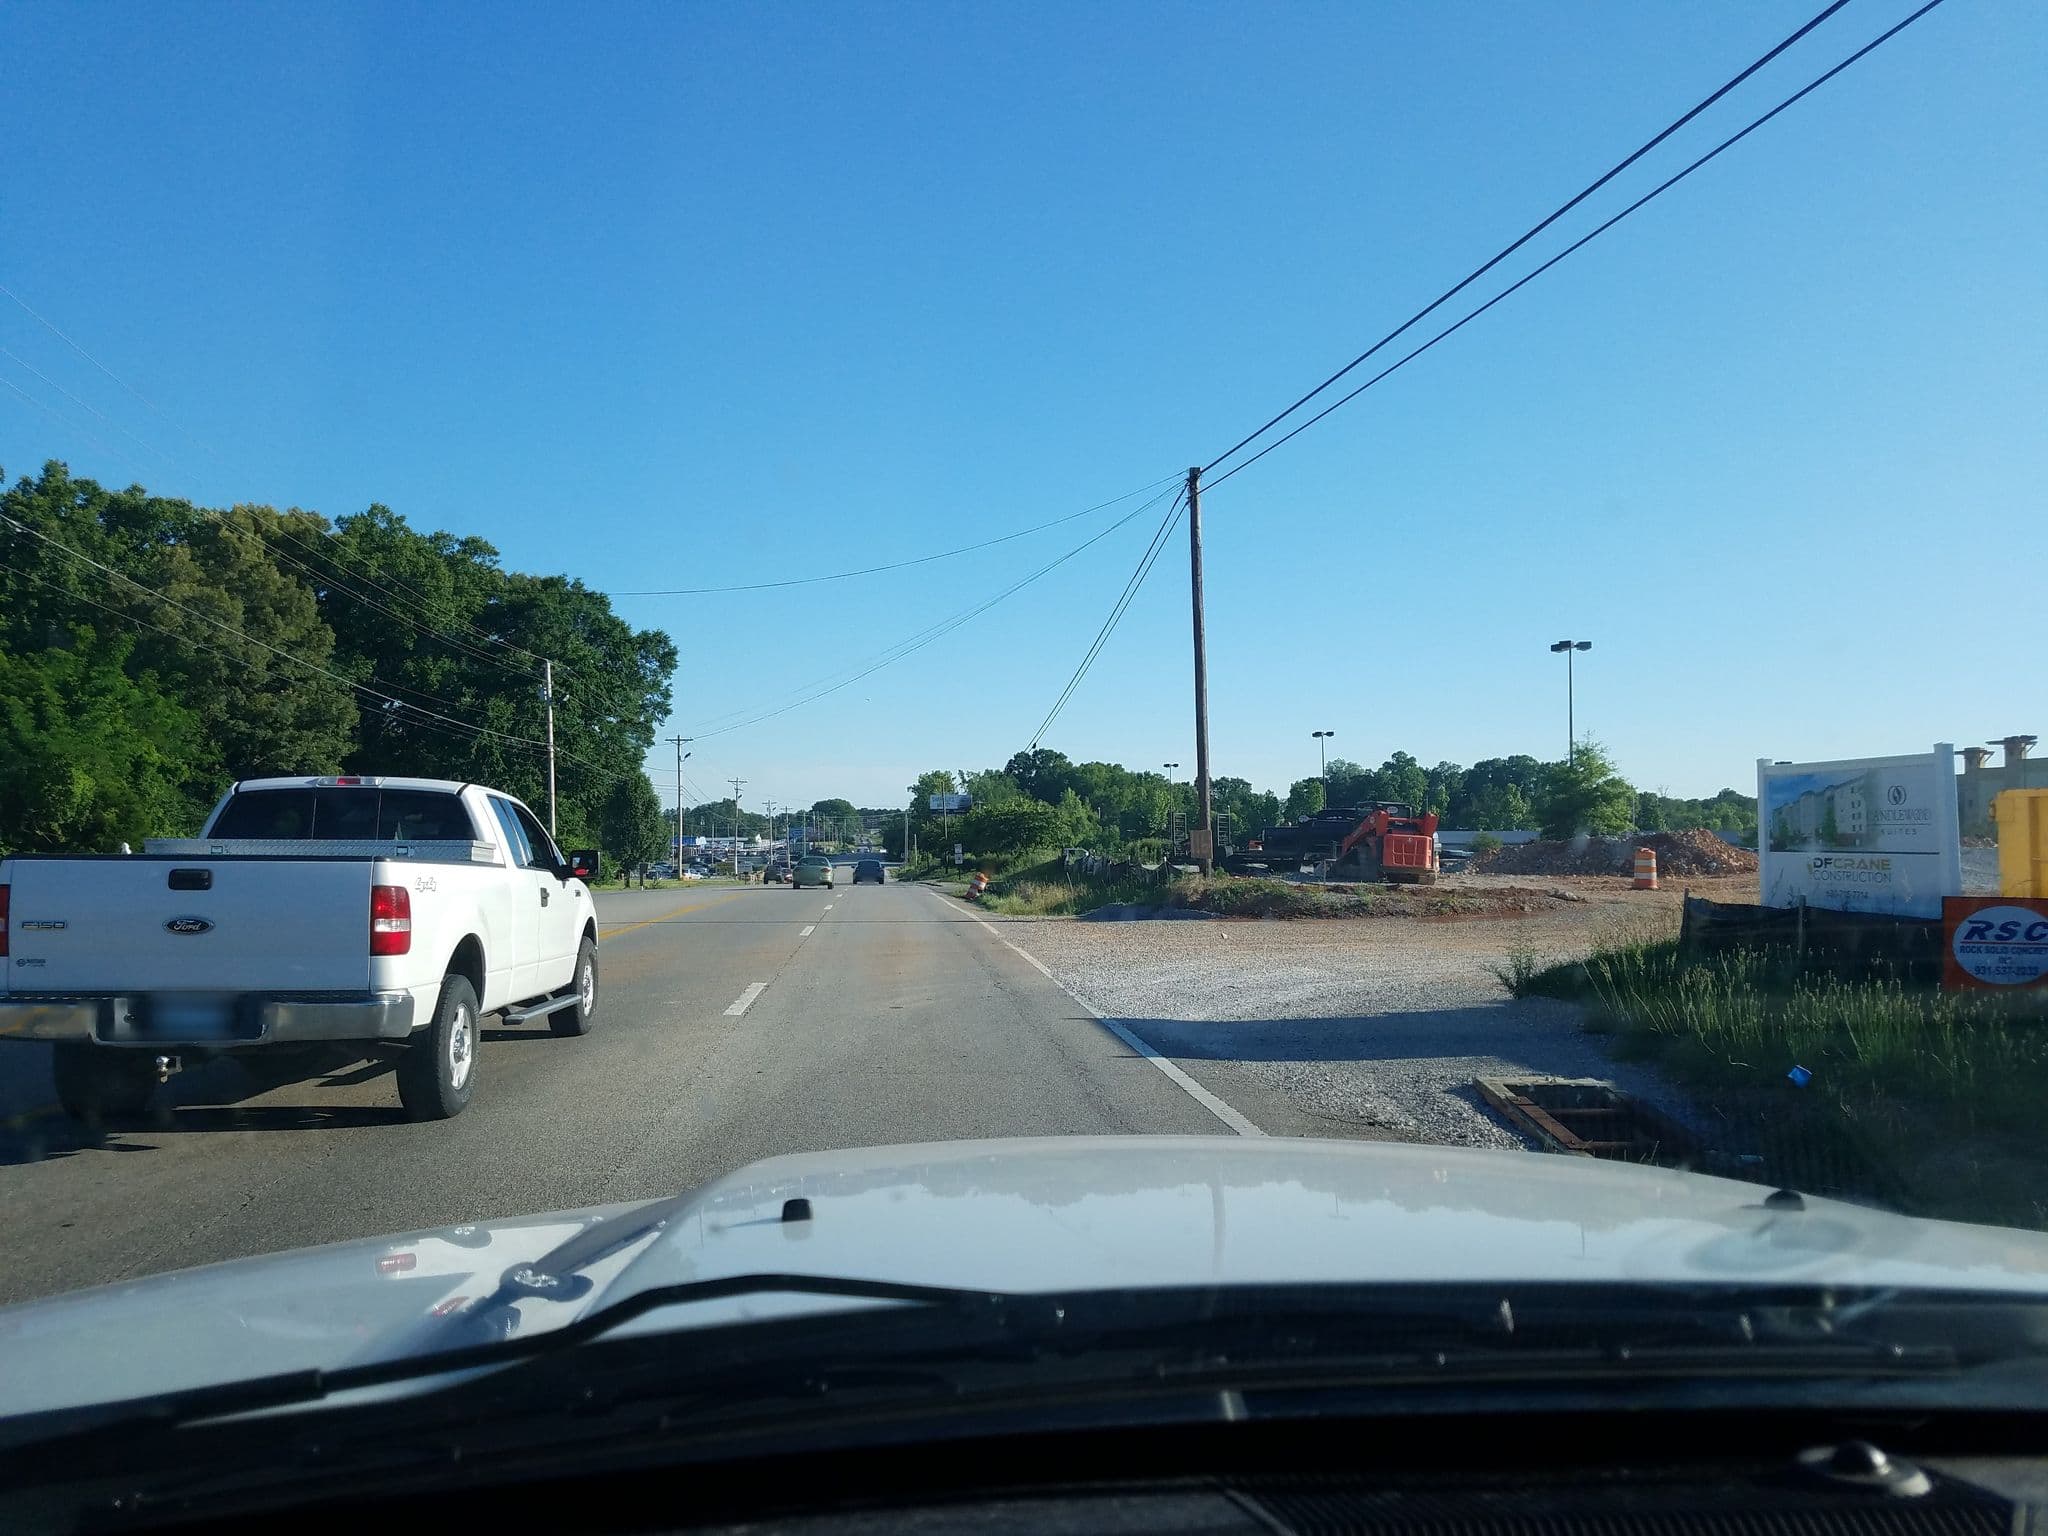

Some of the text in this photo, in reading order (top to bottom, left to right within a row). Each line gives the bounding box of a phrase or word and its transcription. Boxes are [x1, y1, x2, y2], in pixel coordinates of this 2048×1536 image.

[1813, 869, 1892, 883] CONSTRUCTION
[1963, 919, 2048, 941] RSC
[1960, 945, 1982, 954] ROCK
[1984, 946, 2009, 955] SOLID
